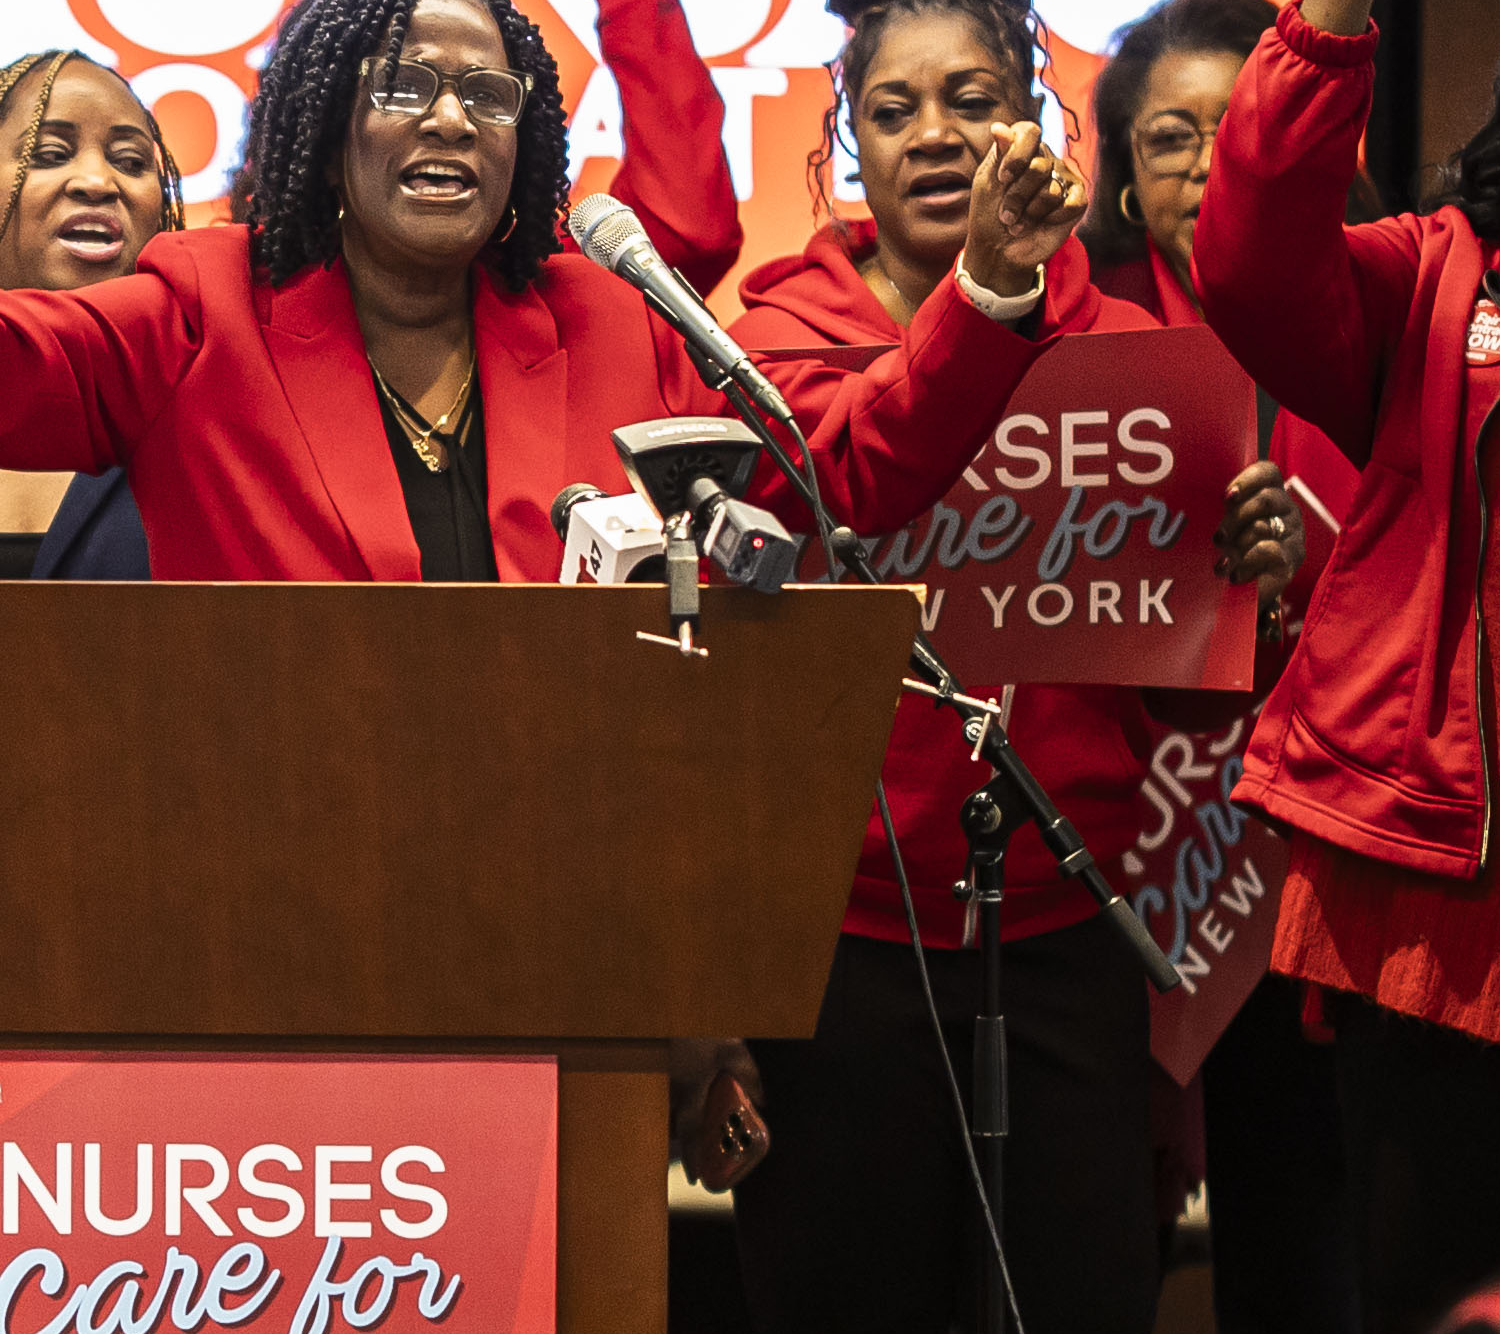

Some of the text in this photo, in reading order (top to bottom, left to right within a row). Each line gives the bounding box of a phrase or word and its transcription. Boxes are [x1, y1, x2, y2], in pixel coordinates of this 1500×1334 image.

[1038, 484, 1186, 582] for
[984, 578, 1175, 631] YORK
[1177, 857, 1266, 996] NEW
[2, 1141, 449, 1239] NURSES
